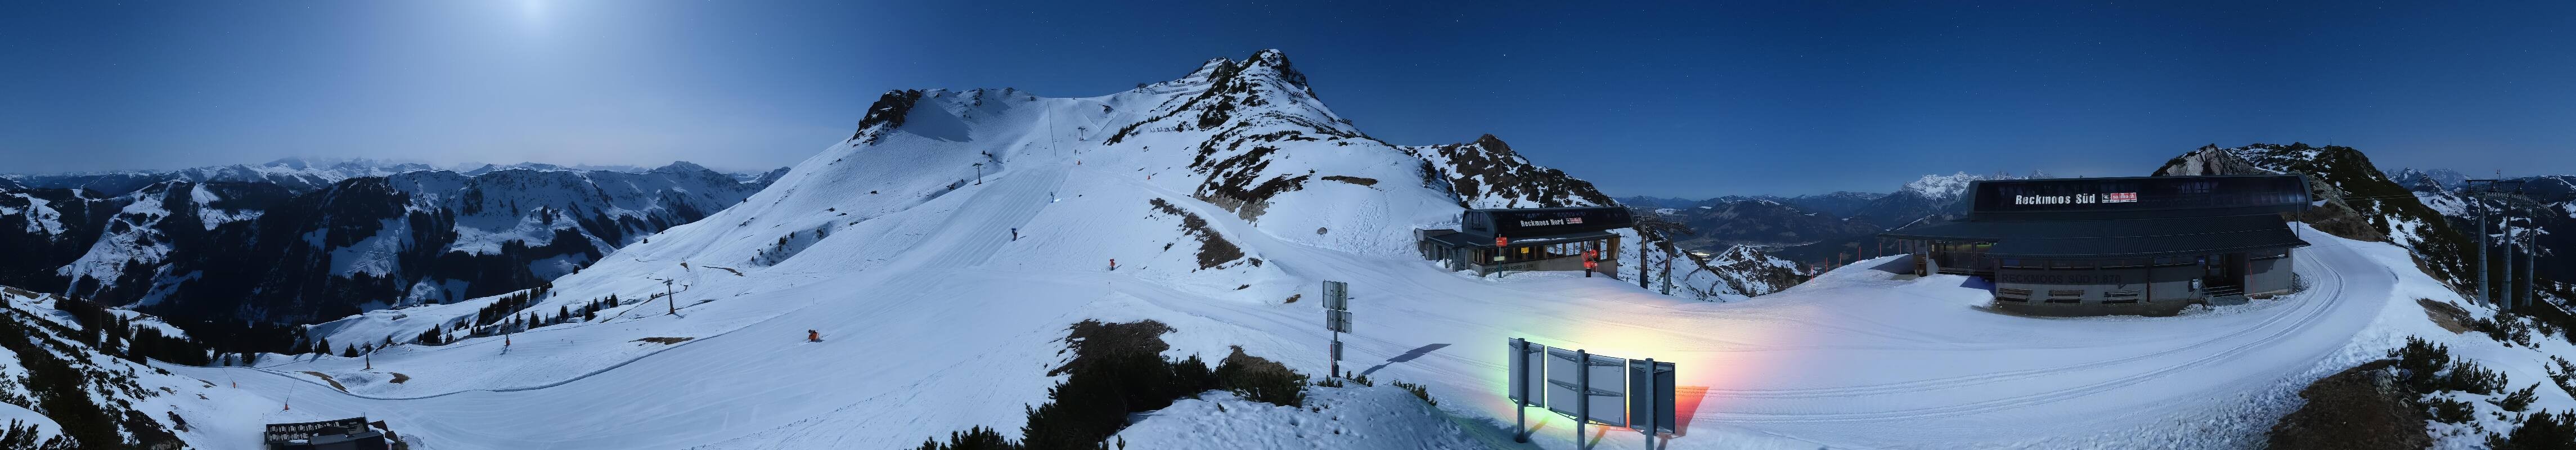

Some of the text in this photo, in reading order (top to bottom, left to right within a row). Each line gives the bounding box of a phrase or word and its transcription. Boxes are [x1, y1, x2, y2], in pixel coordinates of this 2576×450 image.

[2015, 194, 2096, 205] Reckmoos Süd
[2002, 273, 2120, 284] RECKMOOS SÜD 1.870
